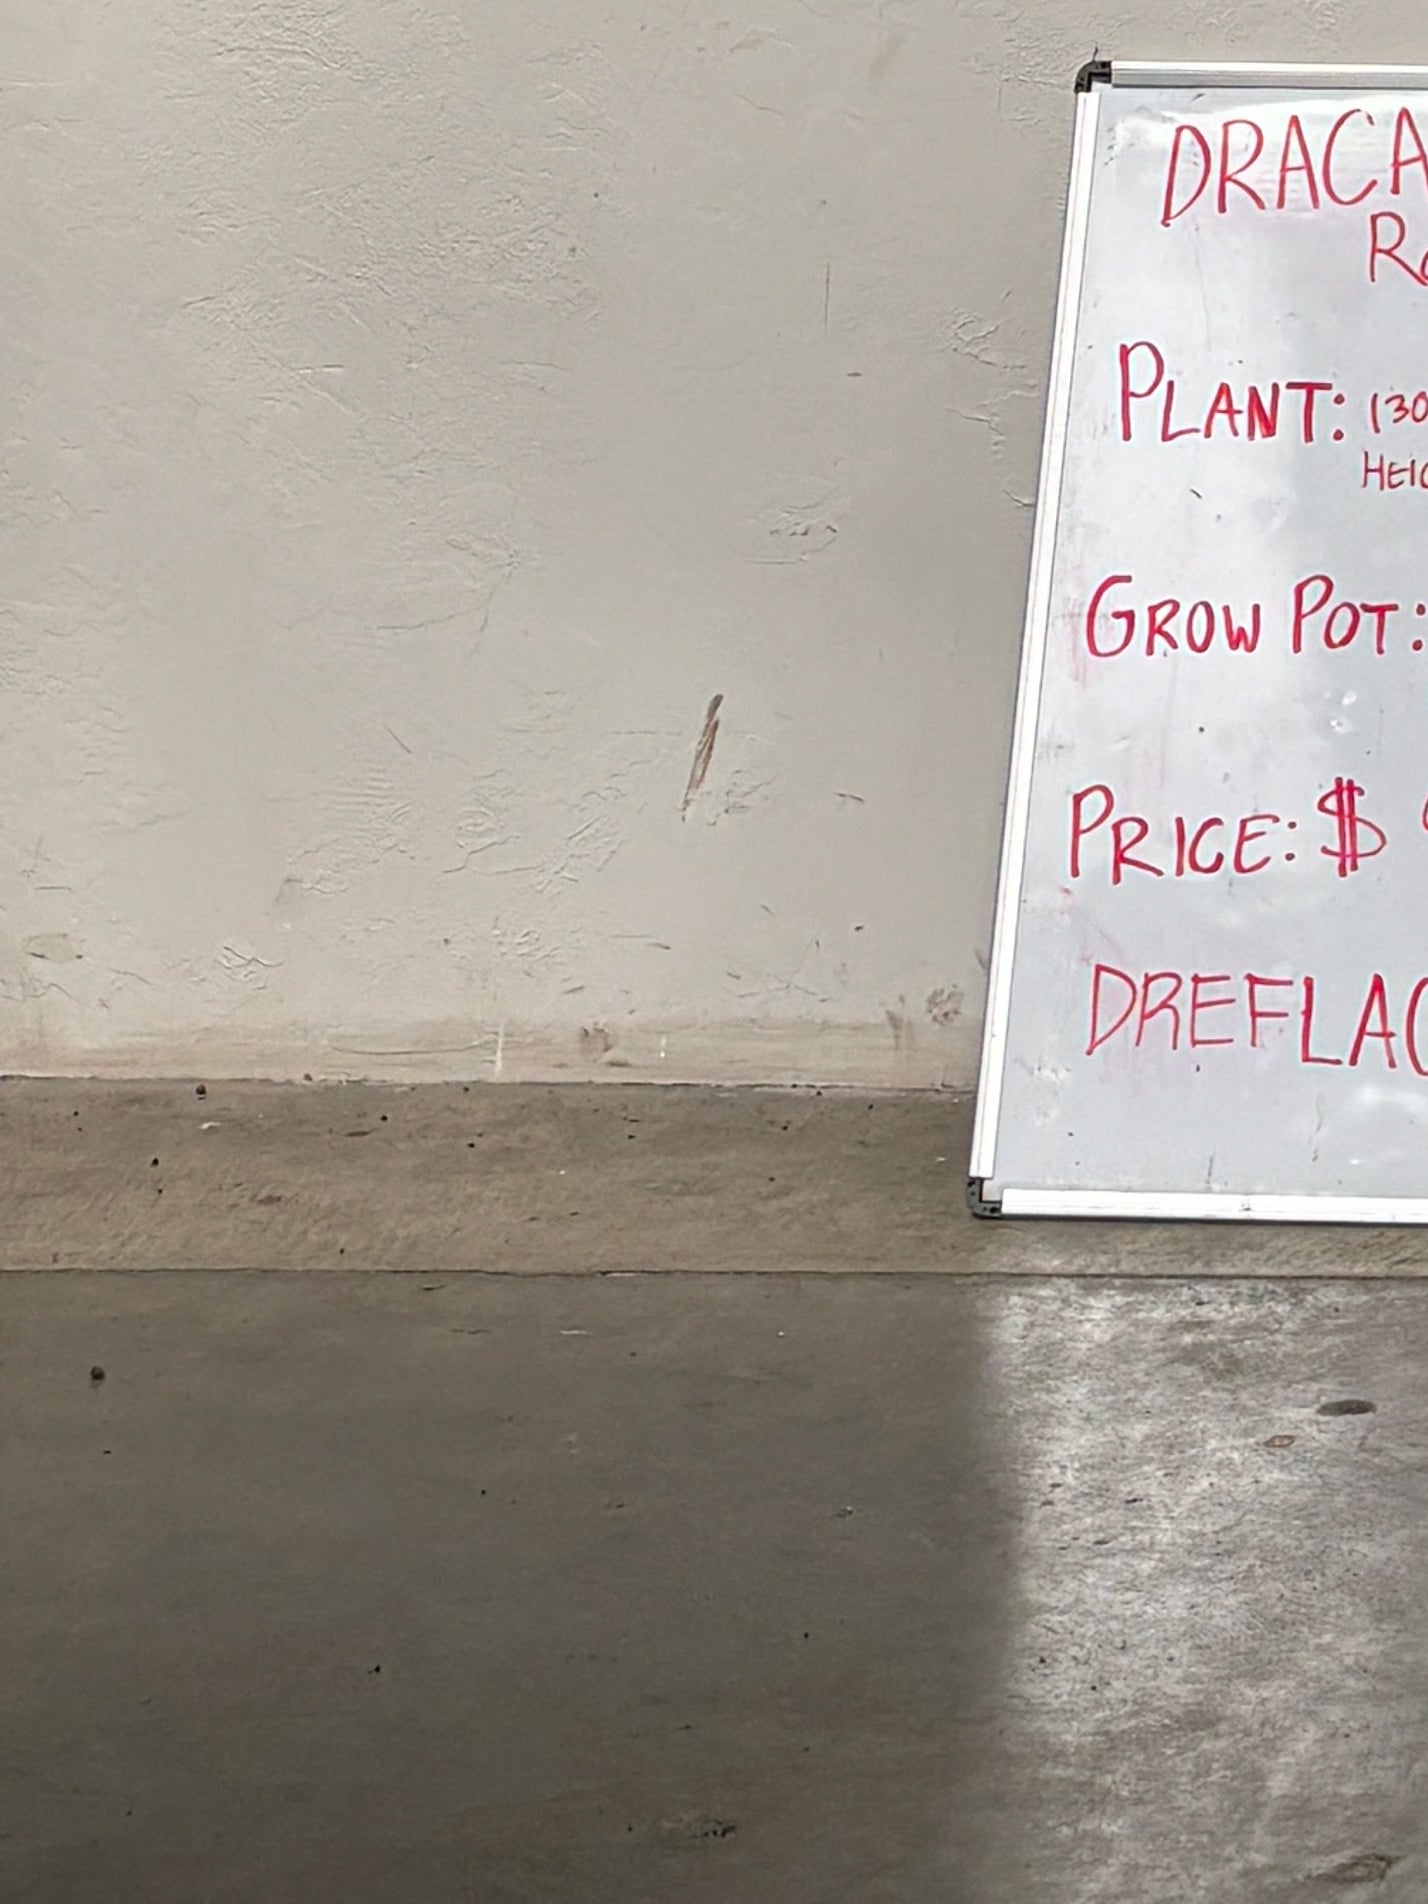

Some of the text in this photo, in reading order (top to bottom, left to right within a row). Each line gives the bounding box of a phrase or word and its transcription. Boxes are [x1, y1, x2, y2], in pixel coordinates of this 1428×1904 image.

[1118, 342, 1346, 444] PLANT:
[1085, 575, 1262, 659] GROW
[1291, 574, 1427, 657] POT:
[1070, 784, 1297, 885] PRICE:
